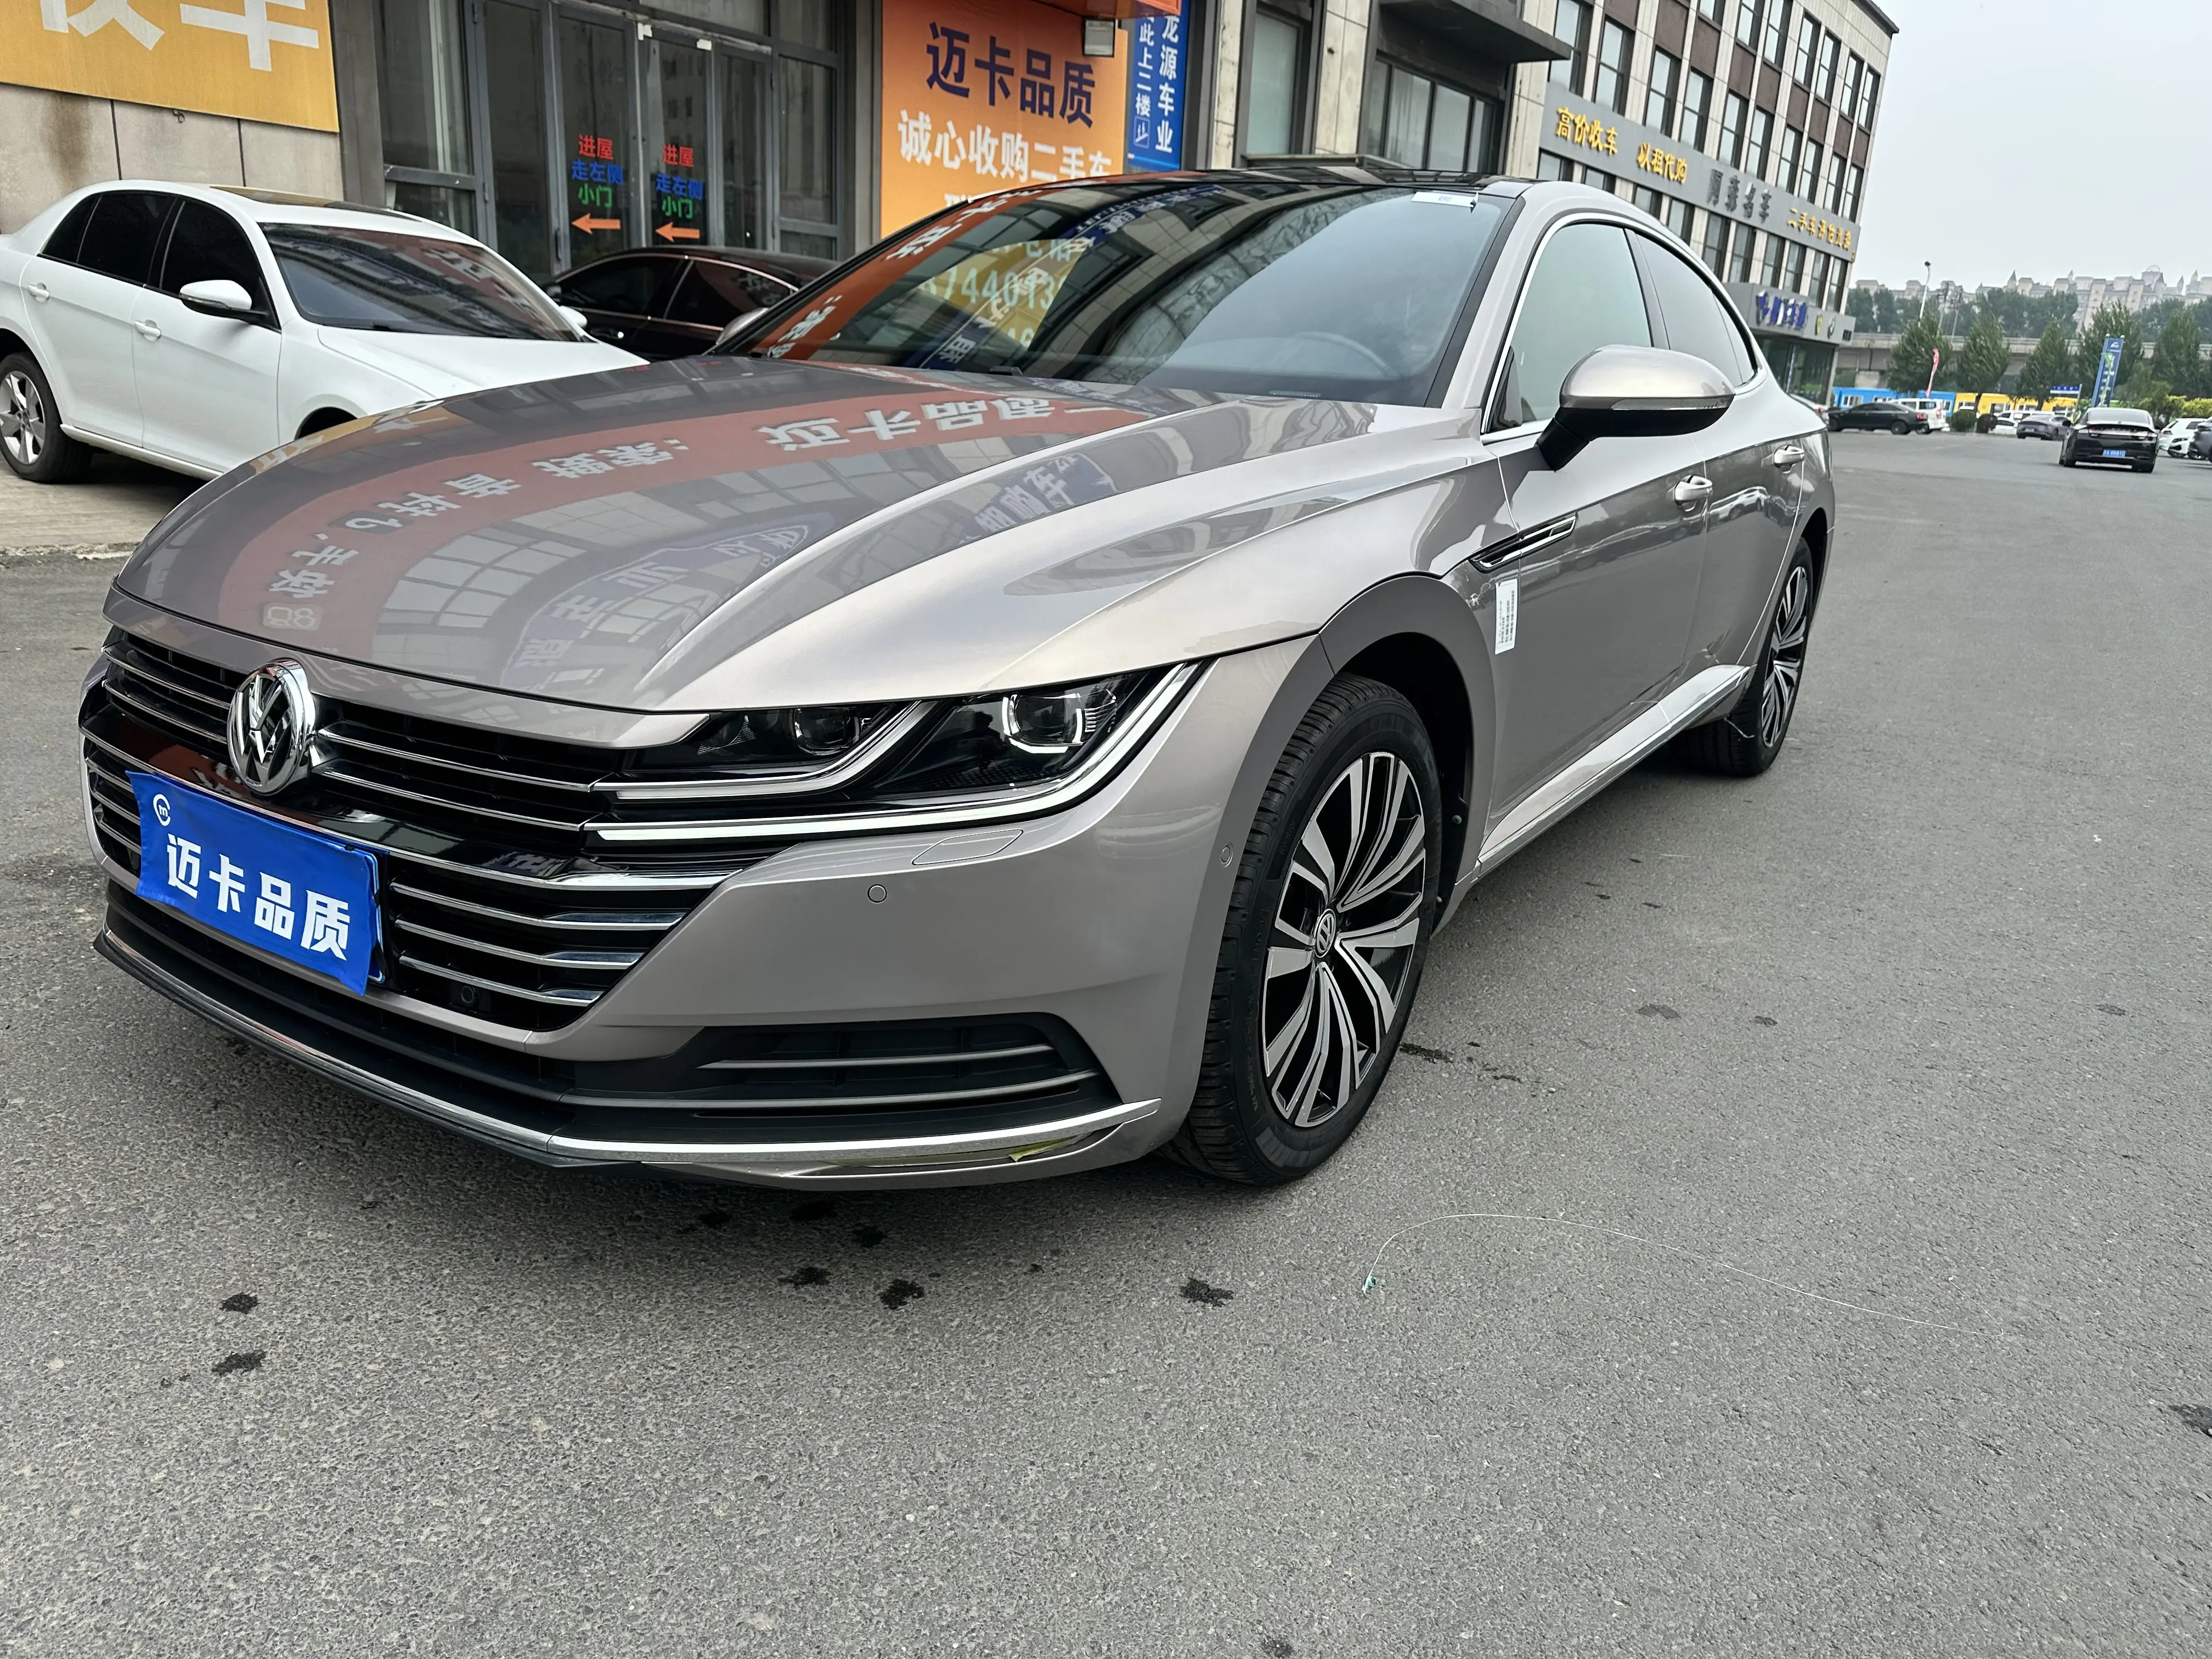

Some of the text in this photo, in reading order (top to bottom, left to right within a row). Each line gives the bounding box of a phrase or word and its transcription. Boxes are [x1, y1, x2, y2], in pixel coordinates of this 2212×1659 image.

[926, 22, 1096, 128] 迈卡品质
[1135, 16, 1154, 118] 此上二楼
[1155, 15, 1180, 154] 龙源车业
[578, 134, 614, 161] 进屋
[897, 109, 1112, 183] 诚心收购二手车
[1556, 106, 1618, 156] 高价收车
[571, 160, 623, 185] 走左侧
[662, 144, 694, 167] 进屋
[1637, 142, 1688, 184] 以租代购
[578, 183, 613, 208] 小门
[655, 173, 704, 201] 走左侧
[662, 196, 693, 219] 小门
[919, 266, 1068, 311] 744013
[166, 833, 351, 961] 迈卡品质
